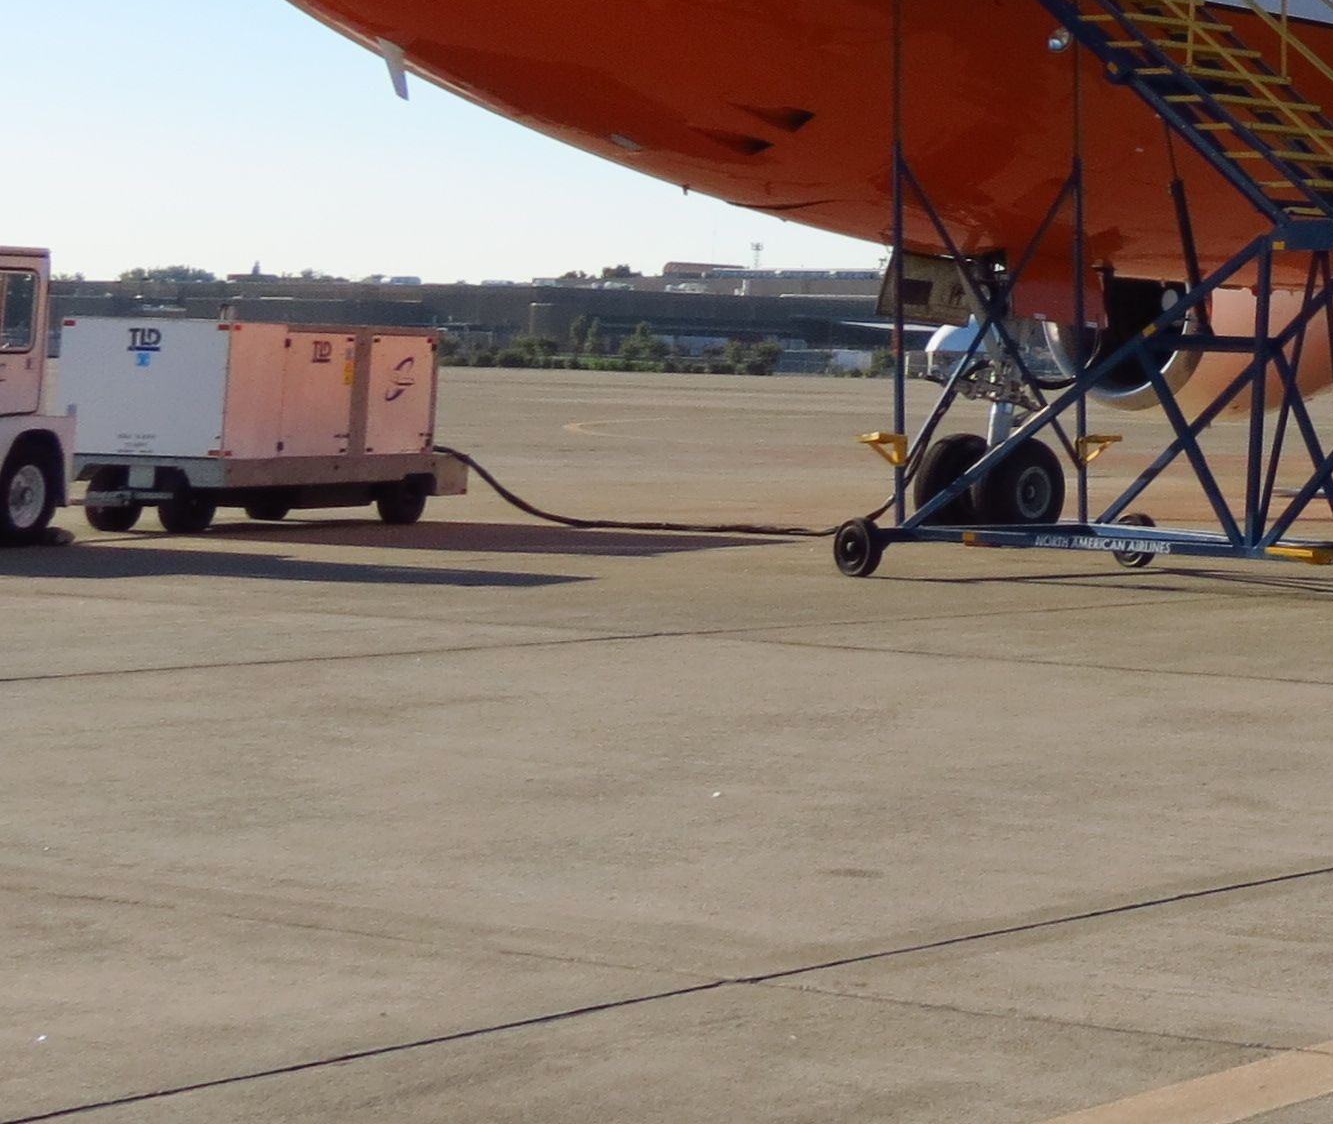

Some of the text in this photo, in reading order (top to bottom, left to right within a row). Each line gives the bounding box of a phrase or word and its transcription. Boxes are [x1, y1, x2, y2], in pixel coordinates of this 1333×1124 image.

[129, 328, 162, 348] TLD
[313, 340, 333, 358] TLD
[1035, 535, 1172, 554] NORTH AMERICAN AIRLINES
